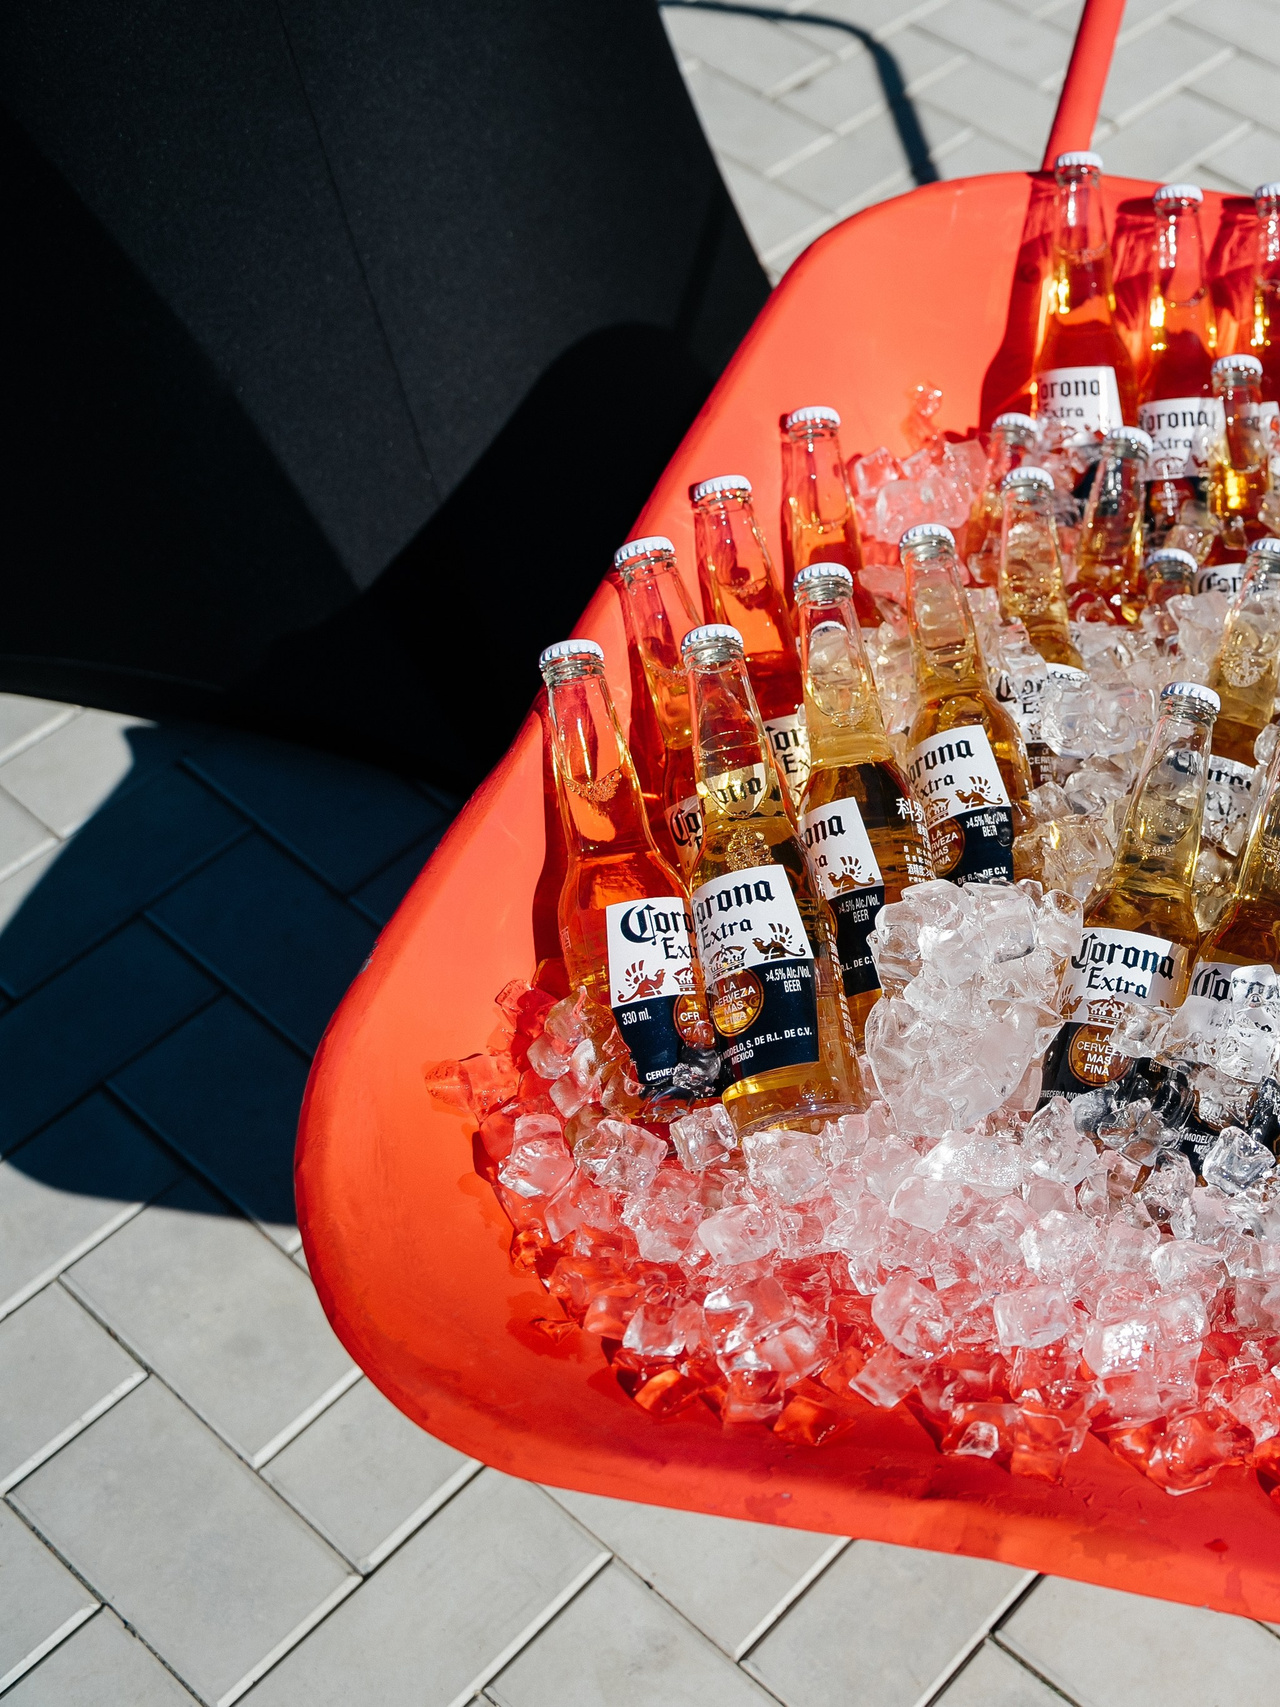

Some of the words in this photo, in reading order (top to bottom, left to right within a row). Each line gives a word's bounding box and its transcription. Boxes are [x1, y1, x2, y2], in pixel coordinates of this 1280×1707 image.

[1038, 378, 1100, 400] orona
[907, 739, 975, 784] orona
[804, 815, 847, 848] ona
[931, 829, 943, 841] LA
[932, 831, 958, 852] RVEZA
[957, 876, 967, 885] DE
[982, 868, 993, 878] DE
[994, 866, 1009, 875] C.V.
[693, 880, 775, 925] orona
[620, 904, 694, 945] Coro
[853, 909, 870, 923] BEER
[702, 918, 753, 950] Extra
[661, 936, 699, 960] Extr
[854, 958, 864, 969] DE
[723, 981, 736, 994] LA
[784, 979, 802, 993] BEER
[1086, 966, 1149, 999] Extra
[714, 985, 756, 1007] CERVEZA
[622, 1011, 638, 1025] 330
[638, 1007, 652, 1022] ml.
[724, 1001, 745, 1016] MAS
[746, 1039, 754, 1049] S.
[754, 1035, 766, 1046] DE
[766, 1032, 783, 1043] R.L.
[784, 1028, 796, 1039] DE
[796, 1027, 813, 1037] C.V.
[1096, 1033, 1110, 1043] LA
[731, 1050, 754, 1066] MEXICO
[1086, 1053, 1112, 1066] MAS
[1084, 1064, 1110, 1077] FINA
[1184, 1132, 1210, 1144] MODEL
